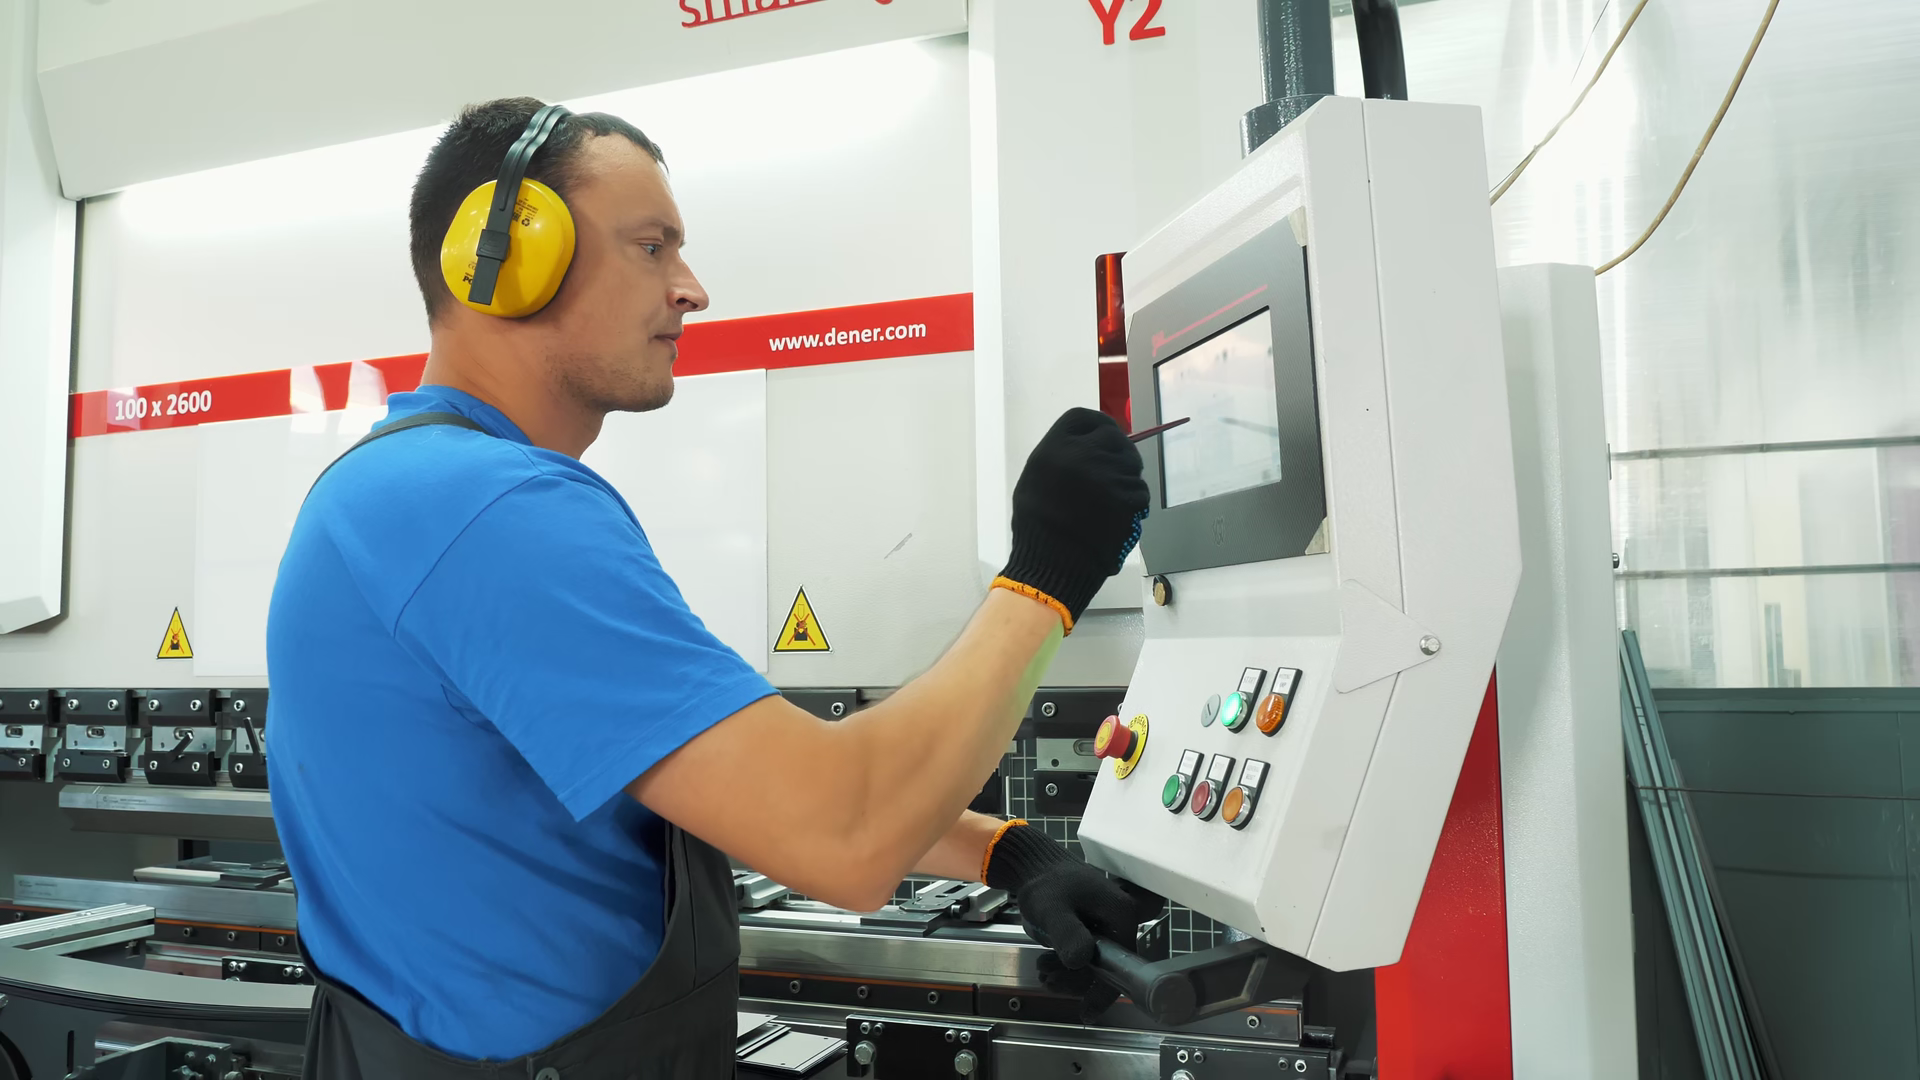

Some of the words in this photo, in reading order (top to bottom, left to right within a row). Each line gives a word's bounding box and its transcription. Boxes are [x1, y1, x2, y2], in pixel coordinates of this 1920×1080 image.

[1088, 0, 1165, 45] Y2
[769, 323, 927, 351] www.dener.com
[115, 397, 148, 420] 100
[151, 400, 162, 417] x
[166, 390, 212, 415] 2600
[1128, 715, 1147, 736] ERGENCY
[1116, 765, 1130, 777] STOP
